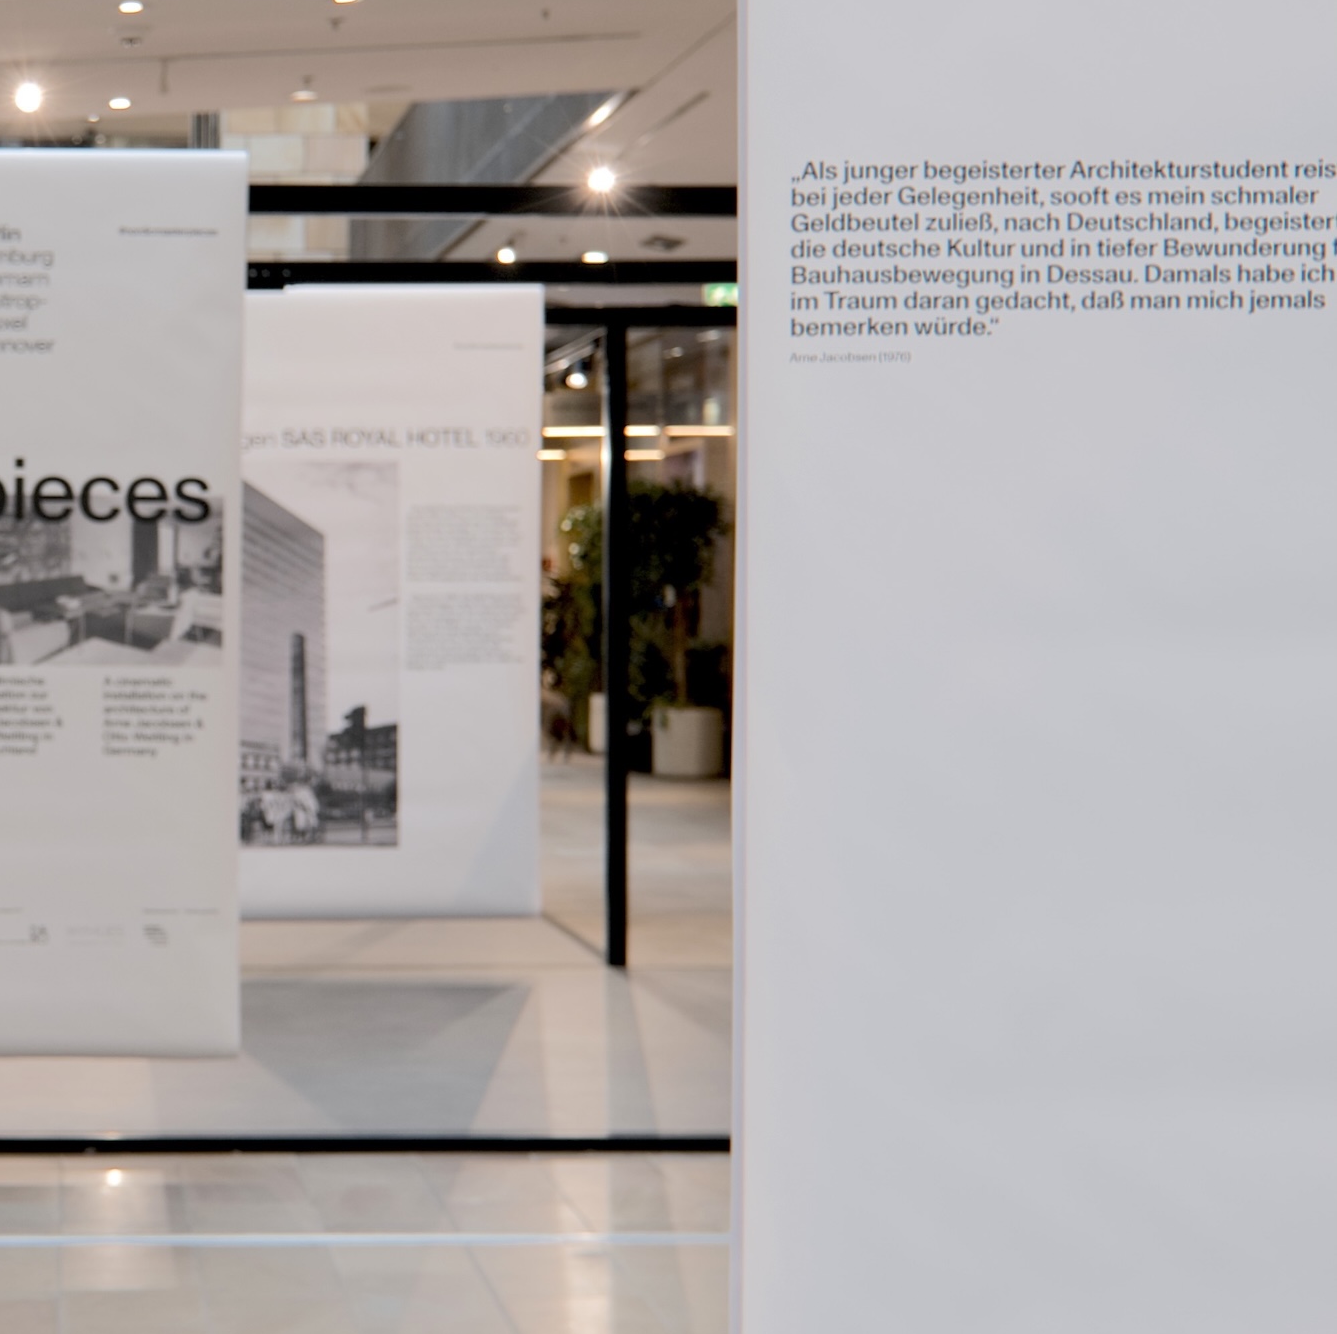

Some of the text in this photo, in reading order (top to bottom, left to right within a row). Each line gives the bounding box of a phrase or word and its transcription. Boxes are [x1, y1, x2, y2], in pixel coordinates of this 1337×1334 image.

[843, 161, 918, 184] junger
[924, 160, 1065, 184] begeisterter
[1070, 160, 1288, 179] Architekturstudent
[791, 186, 1319, 210] bei jeder Gelegenheit, sooft es mein schmaler
[791, 212, 1337, 235] Geldbeutel zuließ, nach Deutschland, begeister
[791, 239, 826, 258] die
[832, 239, 940, 257] deutsche
[948, 238, 1015, 257] Kultur
[1021, 239, 1064, 257] und
[1071, 239, 1090, 257] in
[1097, 239, 1157, 257] tiefer
[1164, 238, 1326, 262] Bewunderung
[792, 264, 1335, 288] Bauhausbewegung in Dessau. Damals habe ich
[791, 290, 1326, 314] im Traum daran gedacht, daß man mich jemals
[791, 317, 908, 336] bemerken
[819, 352, 877, 364] Jacobsen
[281, 427, 326, 448] SAS
[330, 427, 403, 448] ROYAL
[406, 427, 477, 448] HOTEL
